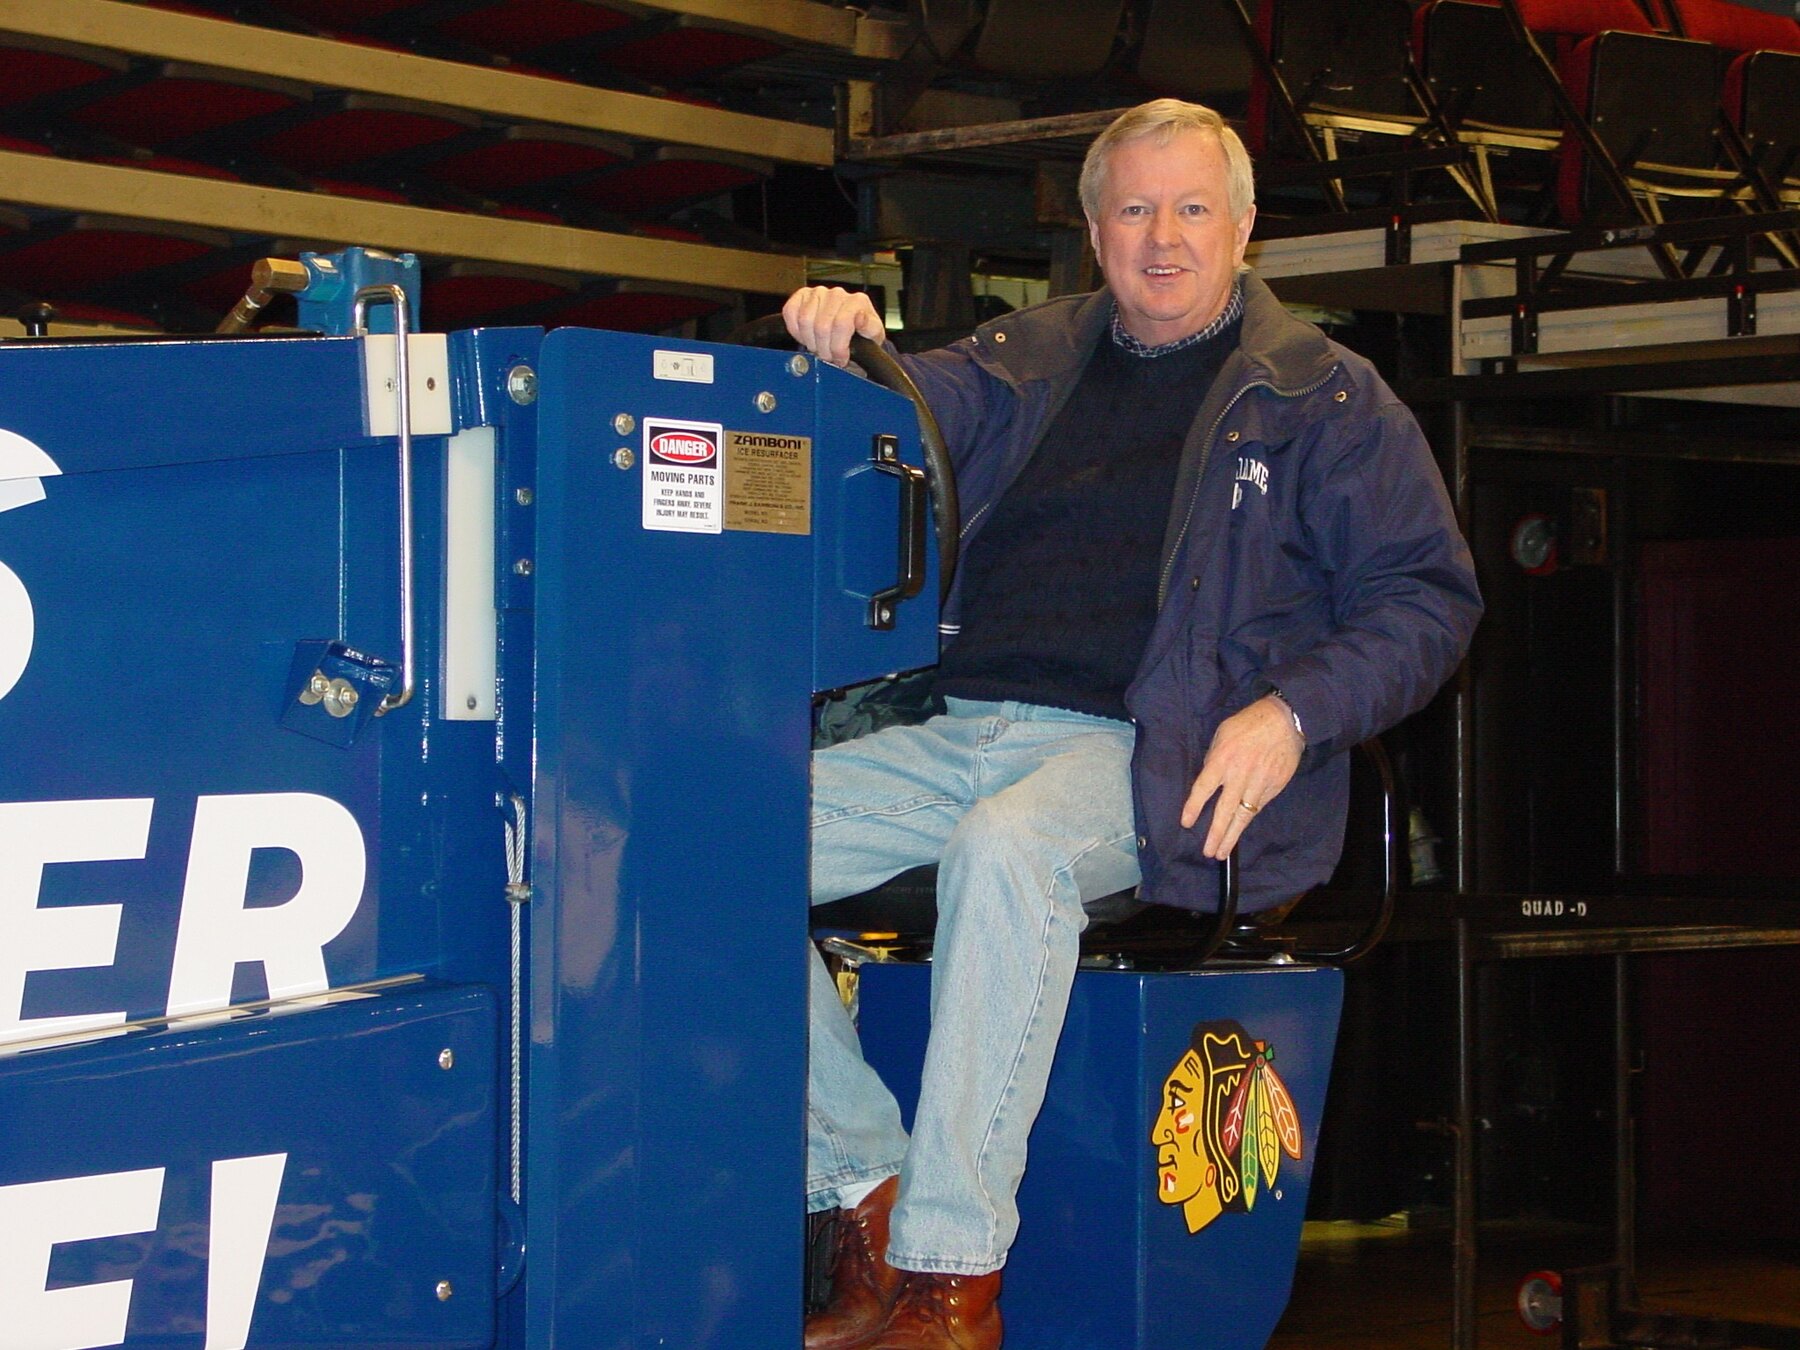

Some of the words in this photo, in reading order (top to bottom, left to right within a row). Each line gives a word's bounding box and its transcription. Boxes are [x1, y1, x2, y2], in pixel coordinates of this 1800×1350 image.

[659, 438, 707, 457] DANGER
[734, 435, 801, 450] ZAMBONI
[737, 447, 749, 456] ICE
[751, 448, 798, 459] RESURFACER
[651, 471, 685, 484] MOVING
[688, 474, 715, 486] PARTS
[675, 490, 692, 498] HANDS
[695, 491, 705, 499] AND
[653, 498, 675, 507] FINGERS
[693, 501, 712, 510] SEVERE
[656, 509, 675, 518] INJURY
[677, 510, 688, 518] MAY
[1522, 900, 1564, 916] QUAD
